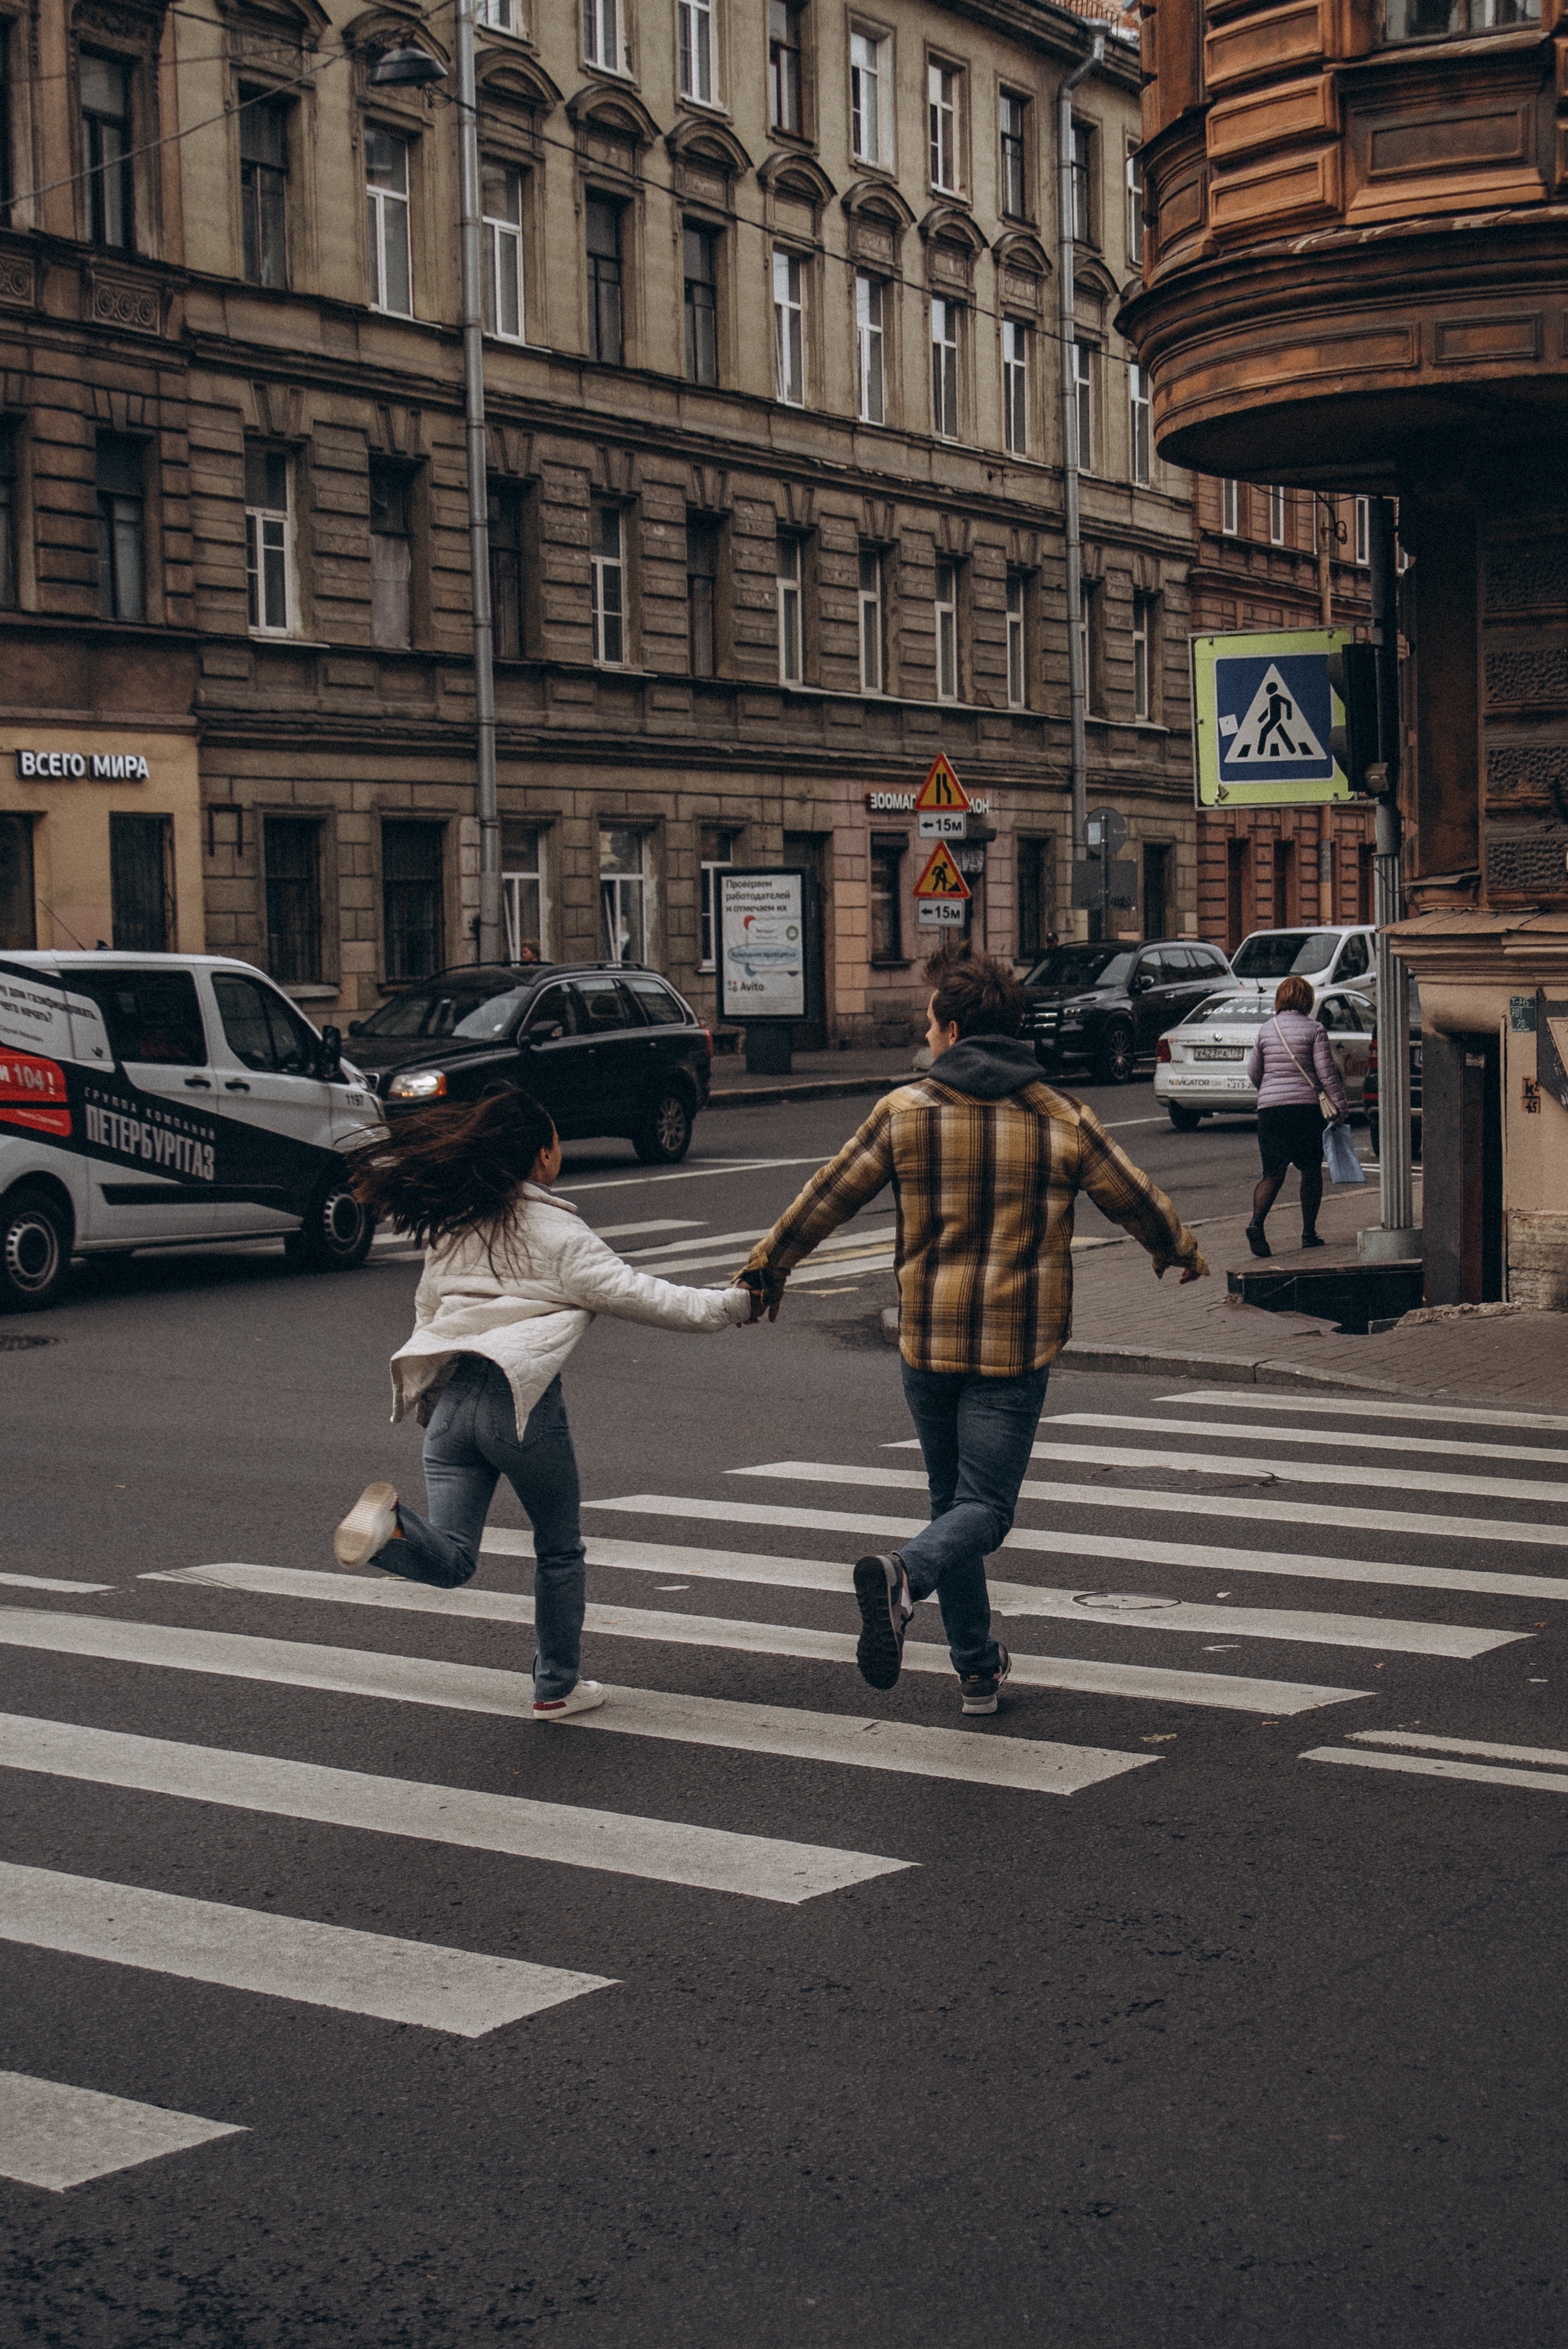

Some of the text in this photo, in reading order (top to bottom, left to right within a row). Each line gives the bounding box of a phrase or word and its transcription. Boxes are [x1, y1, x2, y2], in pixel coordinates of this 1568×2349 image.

[21, 751, 150, 779] ВСЕГО МИРА
[726, 879, 772, 888] Проверяем
[726, 890, 791, 902] работодателей
[740, 981, 765, 992] Avito
[1169, 1078, 1210, 1086] NAVIGATOR
[85, 1086, 137, 1113] ГРУППА
[345, 1094, 364, 1107] 1197
[86, 1104, 215, 1181] ПЕТЕРБУРГГАЗ
